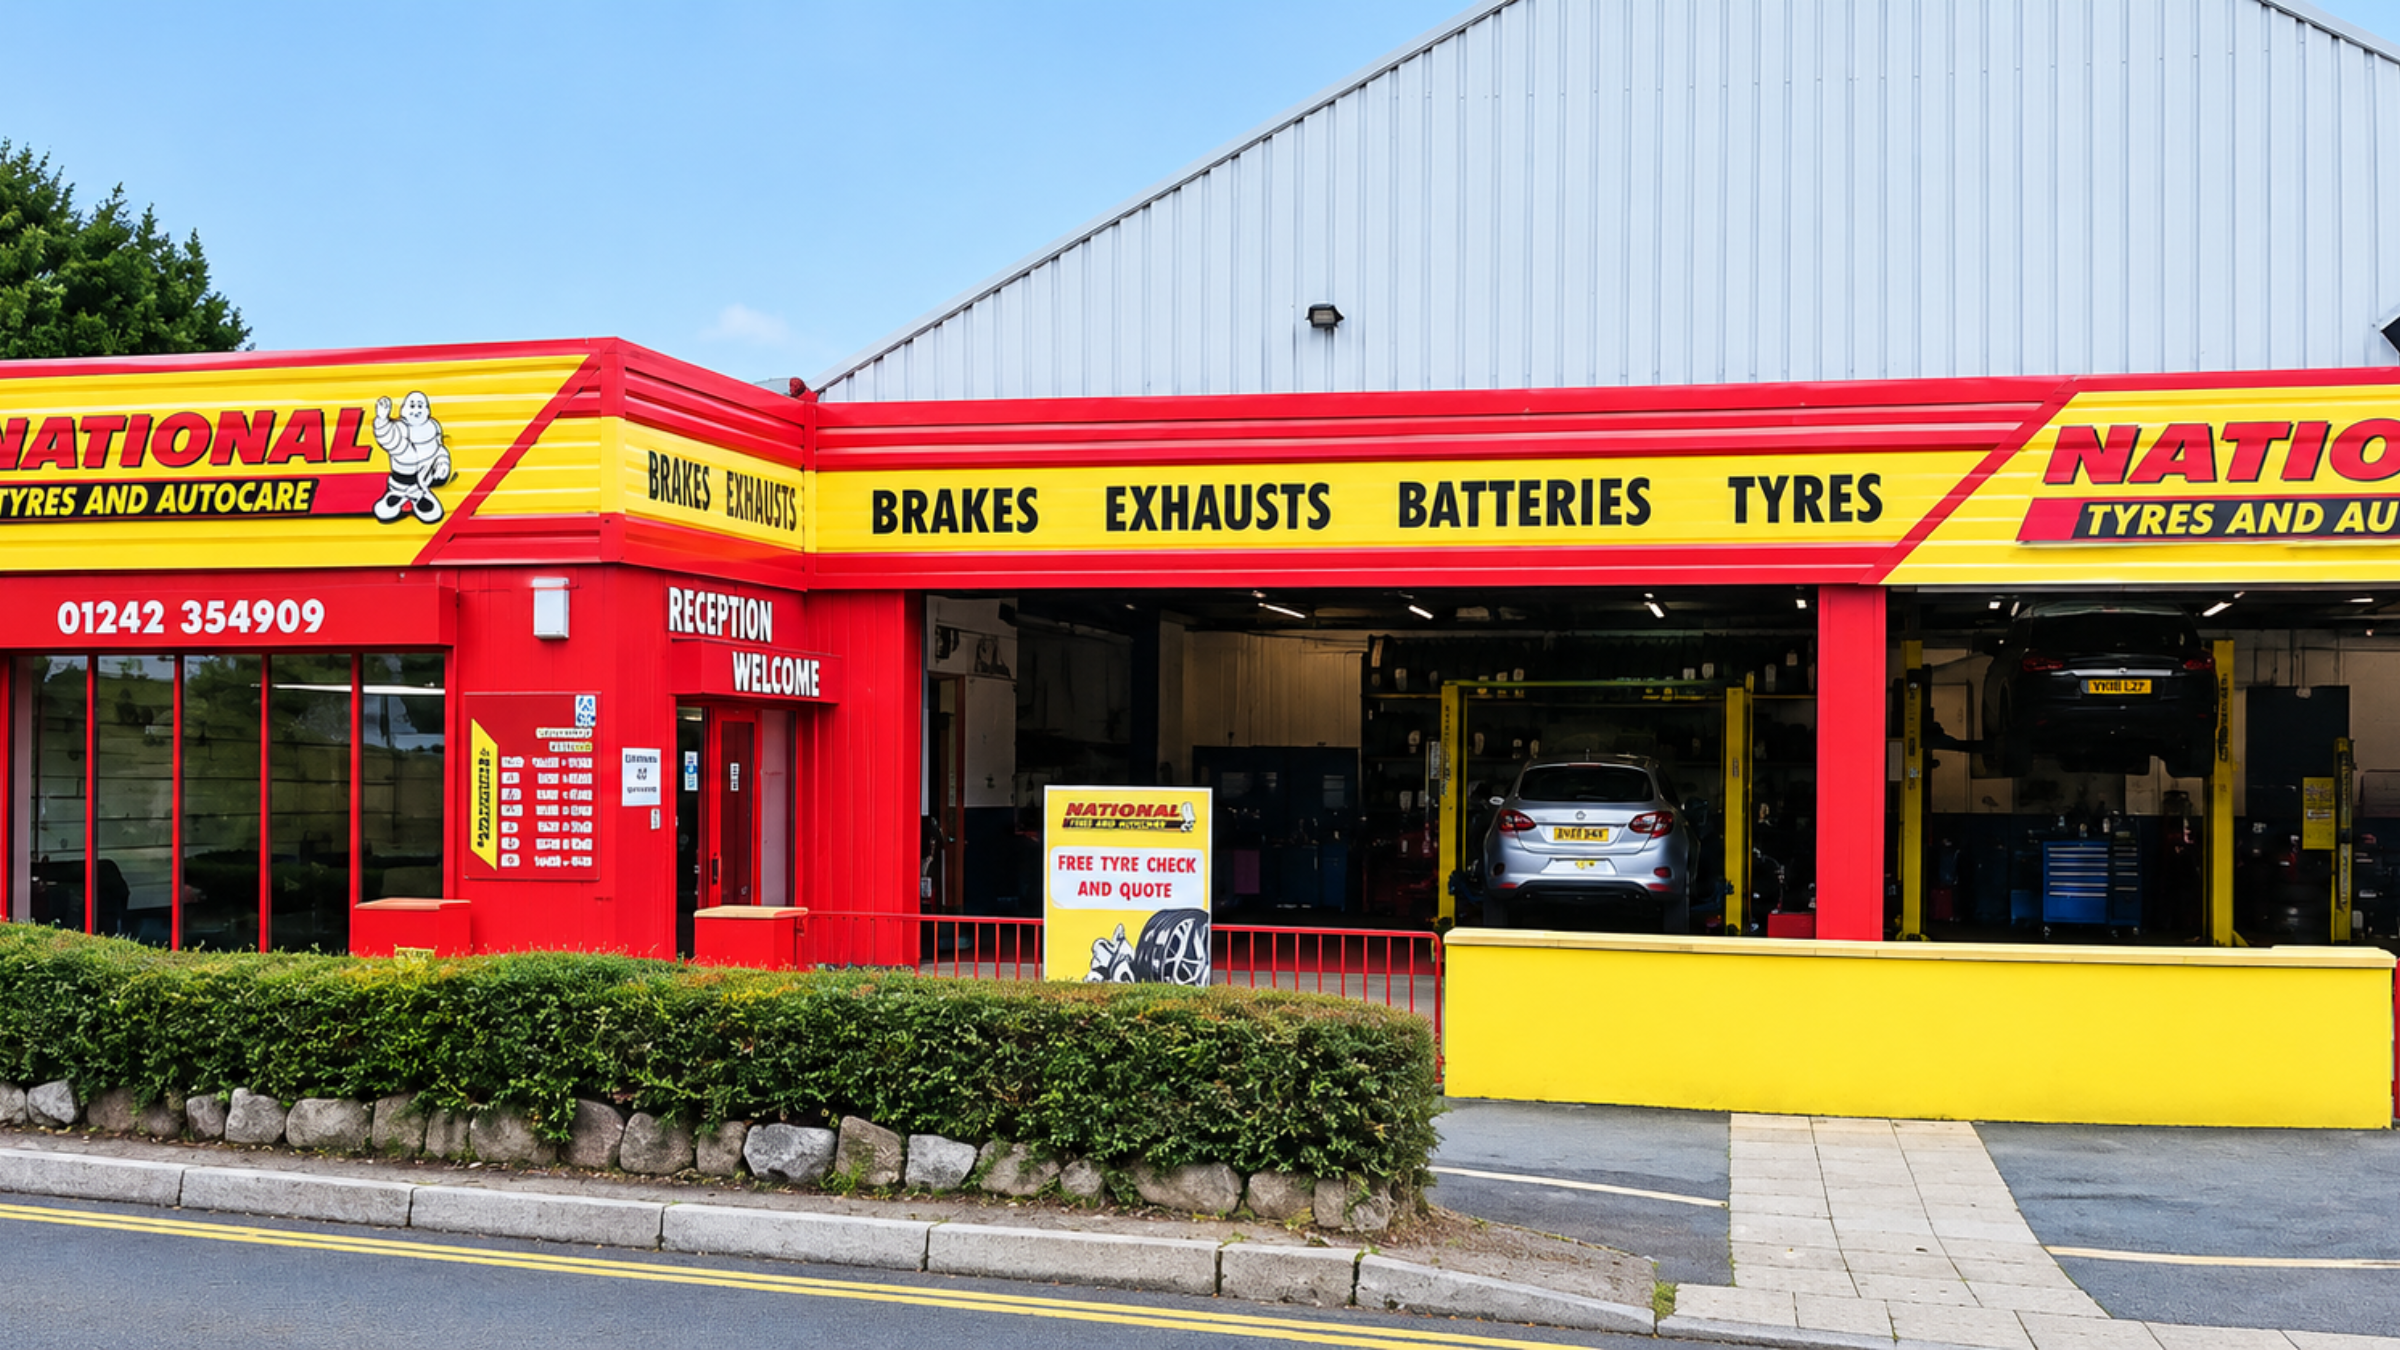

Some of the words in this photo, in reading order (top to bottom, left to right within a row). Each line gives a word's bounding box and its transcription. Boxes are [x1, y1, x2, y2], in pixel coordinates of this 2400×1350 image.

[2042, 417, 2400, 485] NATIO
[82, 484, 148, 515] AND
[154, 481, 312, 514] AUTOCARE
[648, 450, 711, 511] BRAKES
[726, 470, 796, 531] EXHAUSTS
[872, 487, 1039, 535] BRAKES
[1106, 482, 1331, 532] EXHAUSTS
[1399, 477, 1651, 528] BATTERIES
[1728, 473, 1883, 524] TYRES
[2087, 503, 2215, 536] TYRES
[2224, 501, 2325, 534] AND
[57, 600, 164, 635] 01242
[180, 598, 325, 634] 354909
[668, 586, 773, 643] RECEPTION
[732, 651, 820, 698] WELCOME
[1065, 802, 1180, 818] NATIONAL
[1058, 854, 1094, 871] FREE
[1100, 855, 1140, 873] TYRE
[1146, 856, 1197, 874] CHECK
[1077, 880, 1113, 897] AND
[1119, 881, 1173, 902] QUOTE
